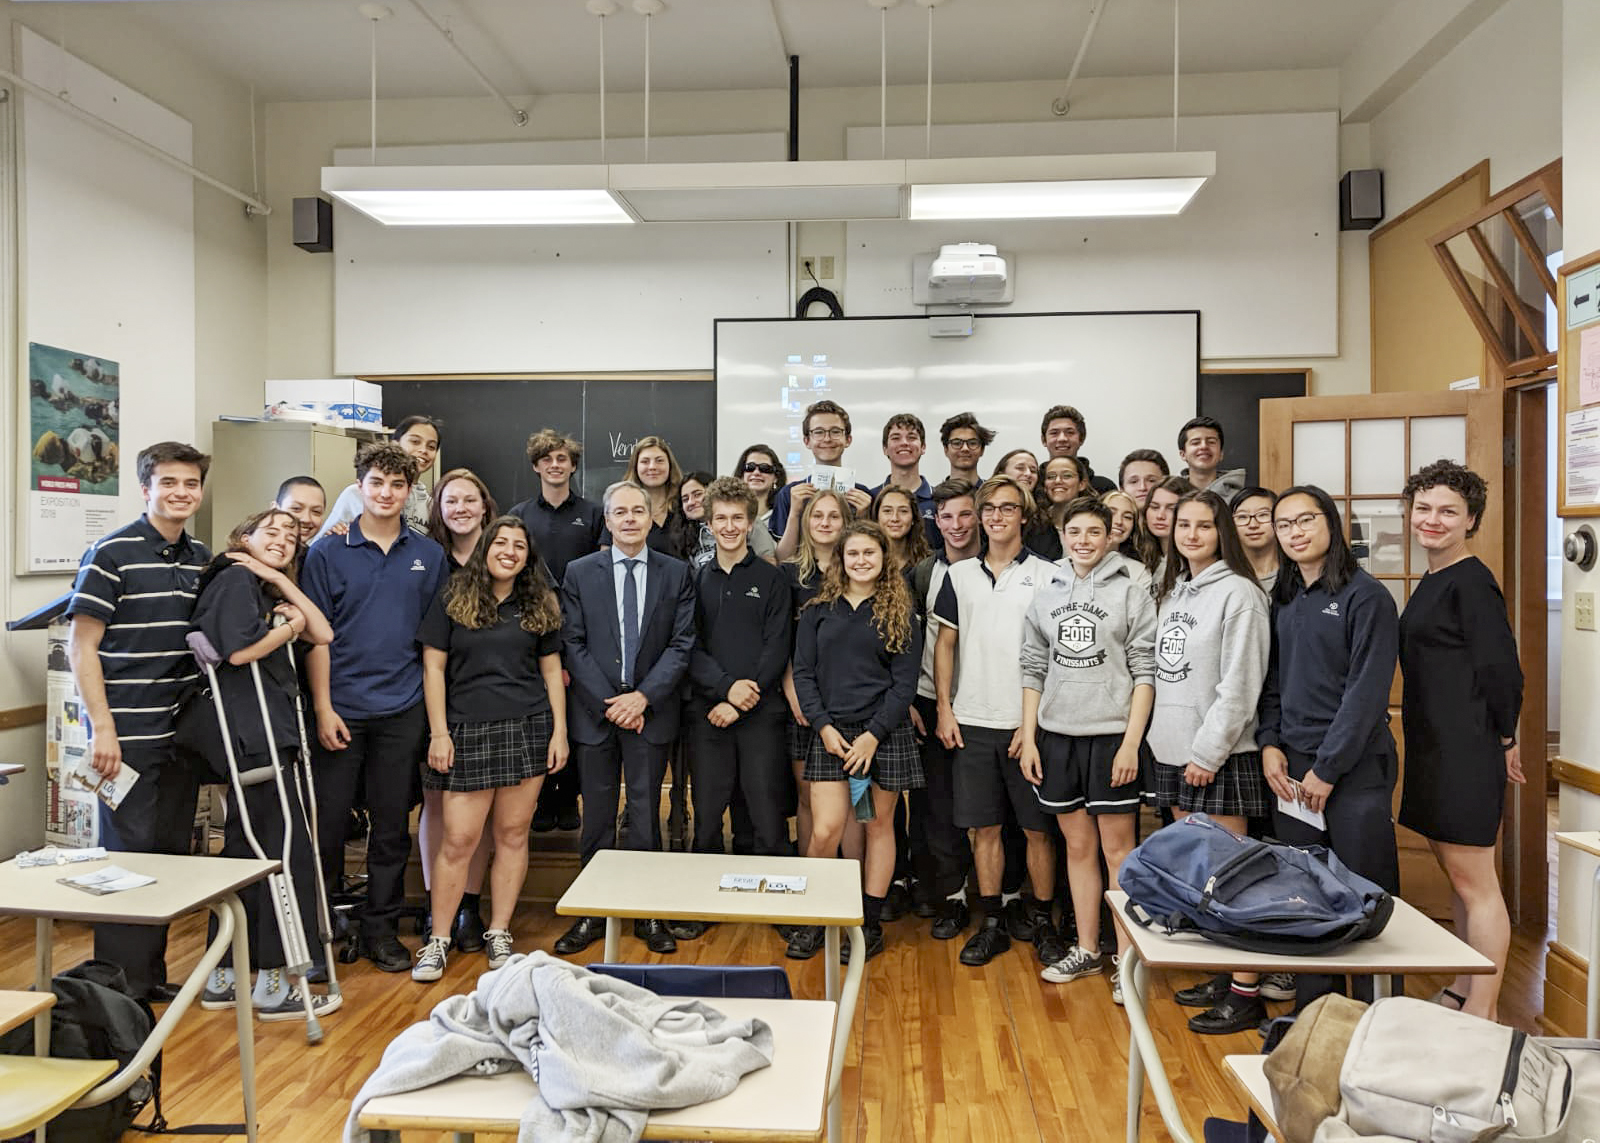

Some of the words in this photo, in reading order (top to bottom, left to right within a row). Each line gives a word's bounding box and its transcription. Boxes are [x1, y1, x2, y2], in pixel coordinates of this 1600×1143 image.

[40, 496, 80, 507] EXPOSITION
[1050, 602, 1109, 620] NOTRE-DAME
[1061, 626, 1093, 642] 2019
[1161, 637, 1184, 654] 2019
[1056, 655, 1100, 667] FINISSANTS
